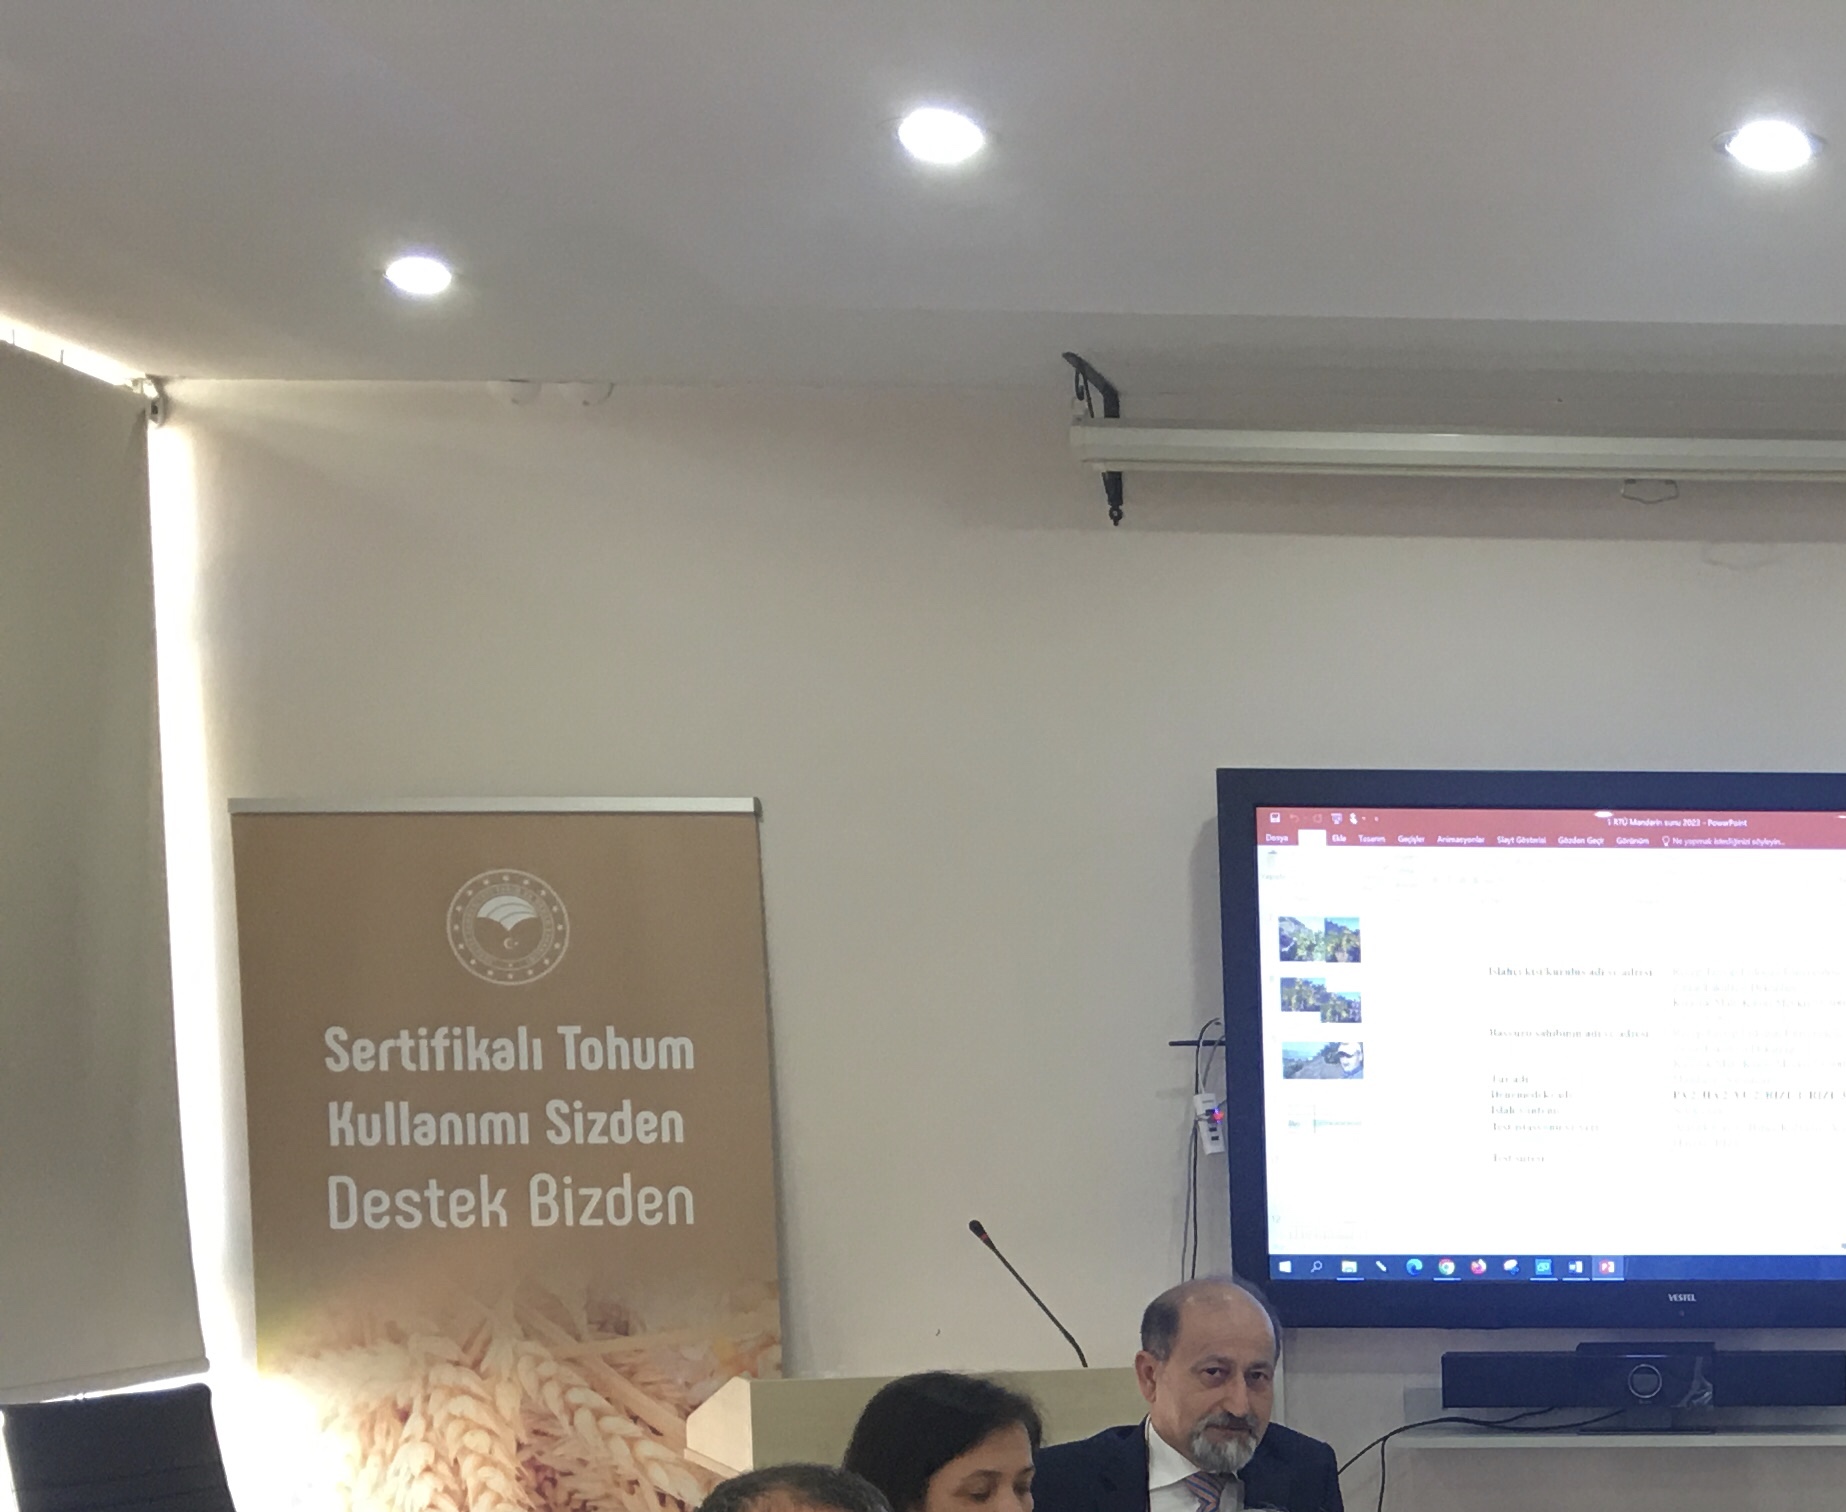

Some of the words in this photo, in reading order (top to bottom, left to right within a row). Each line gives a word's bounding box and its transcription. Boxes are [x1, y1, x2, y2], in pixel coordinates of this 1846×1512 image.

[1708, 818, 1747, 827] PowerPoint
[1265, 834, 1289, 843] Dosya
[1332, 834, 1347, 843] Ekle
[1437, 835, 1485, 845] Animasyonlar
[324, 1025, 543, 1072] Sertifikalı
[557, 1024, 694, 1071] Tohum
[328, 1100, 530, 1147] Kullanımı
[545, 1098, 684, 1145] Sizden
[327, 1173, 508, 1230] Destek
[528, 1172, 695, 1227] Bizden
[1668, 1293, 1697, 1302] VESTEL
